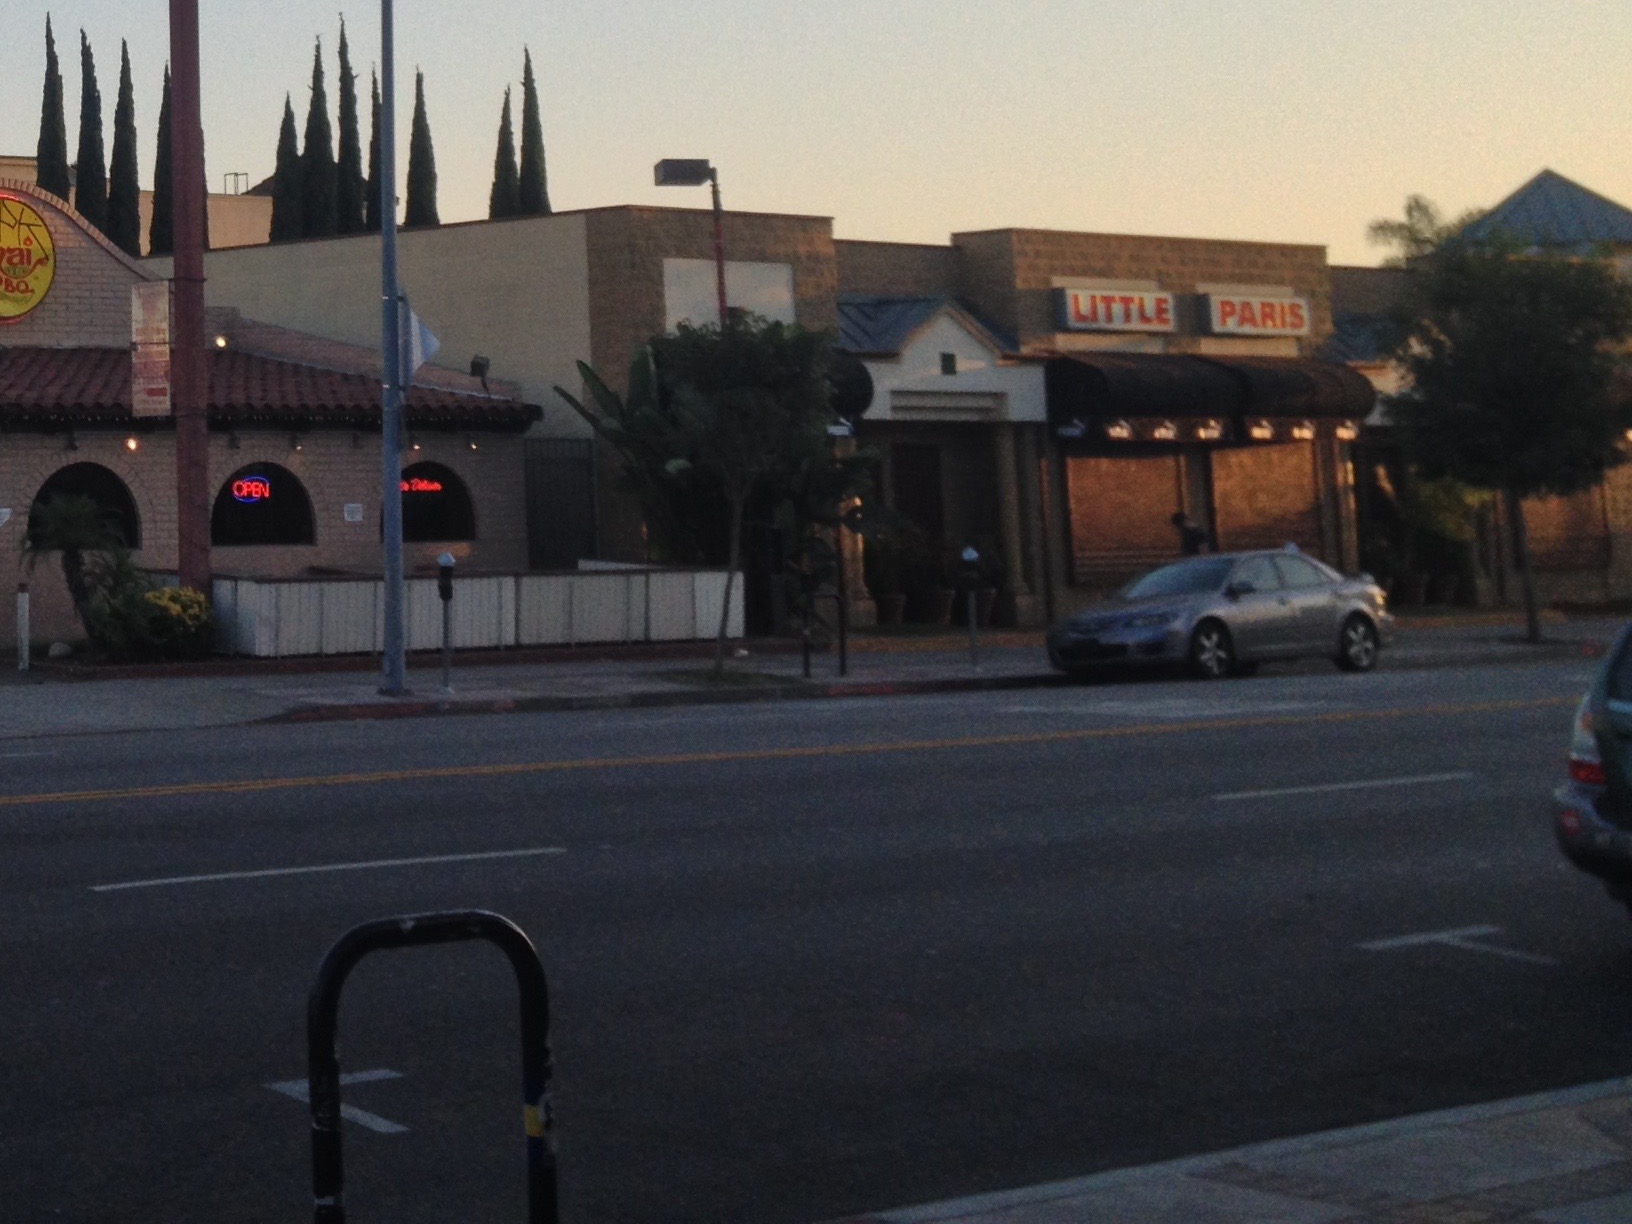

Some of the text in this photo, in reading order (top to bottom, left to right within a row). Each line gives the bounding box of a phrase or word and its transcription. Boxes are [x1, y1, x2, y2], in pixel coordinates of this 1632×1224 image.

[1071, 293, 1305, 330] LITTLE PARIS
[232, 480, 270, 498] OPEN
